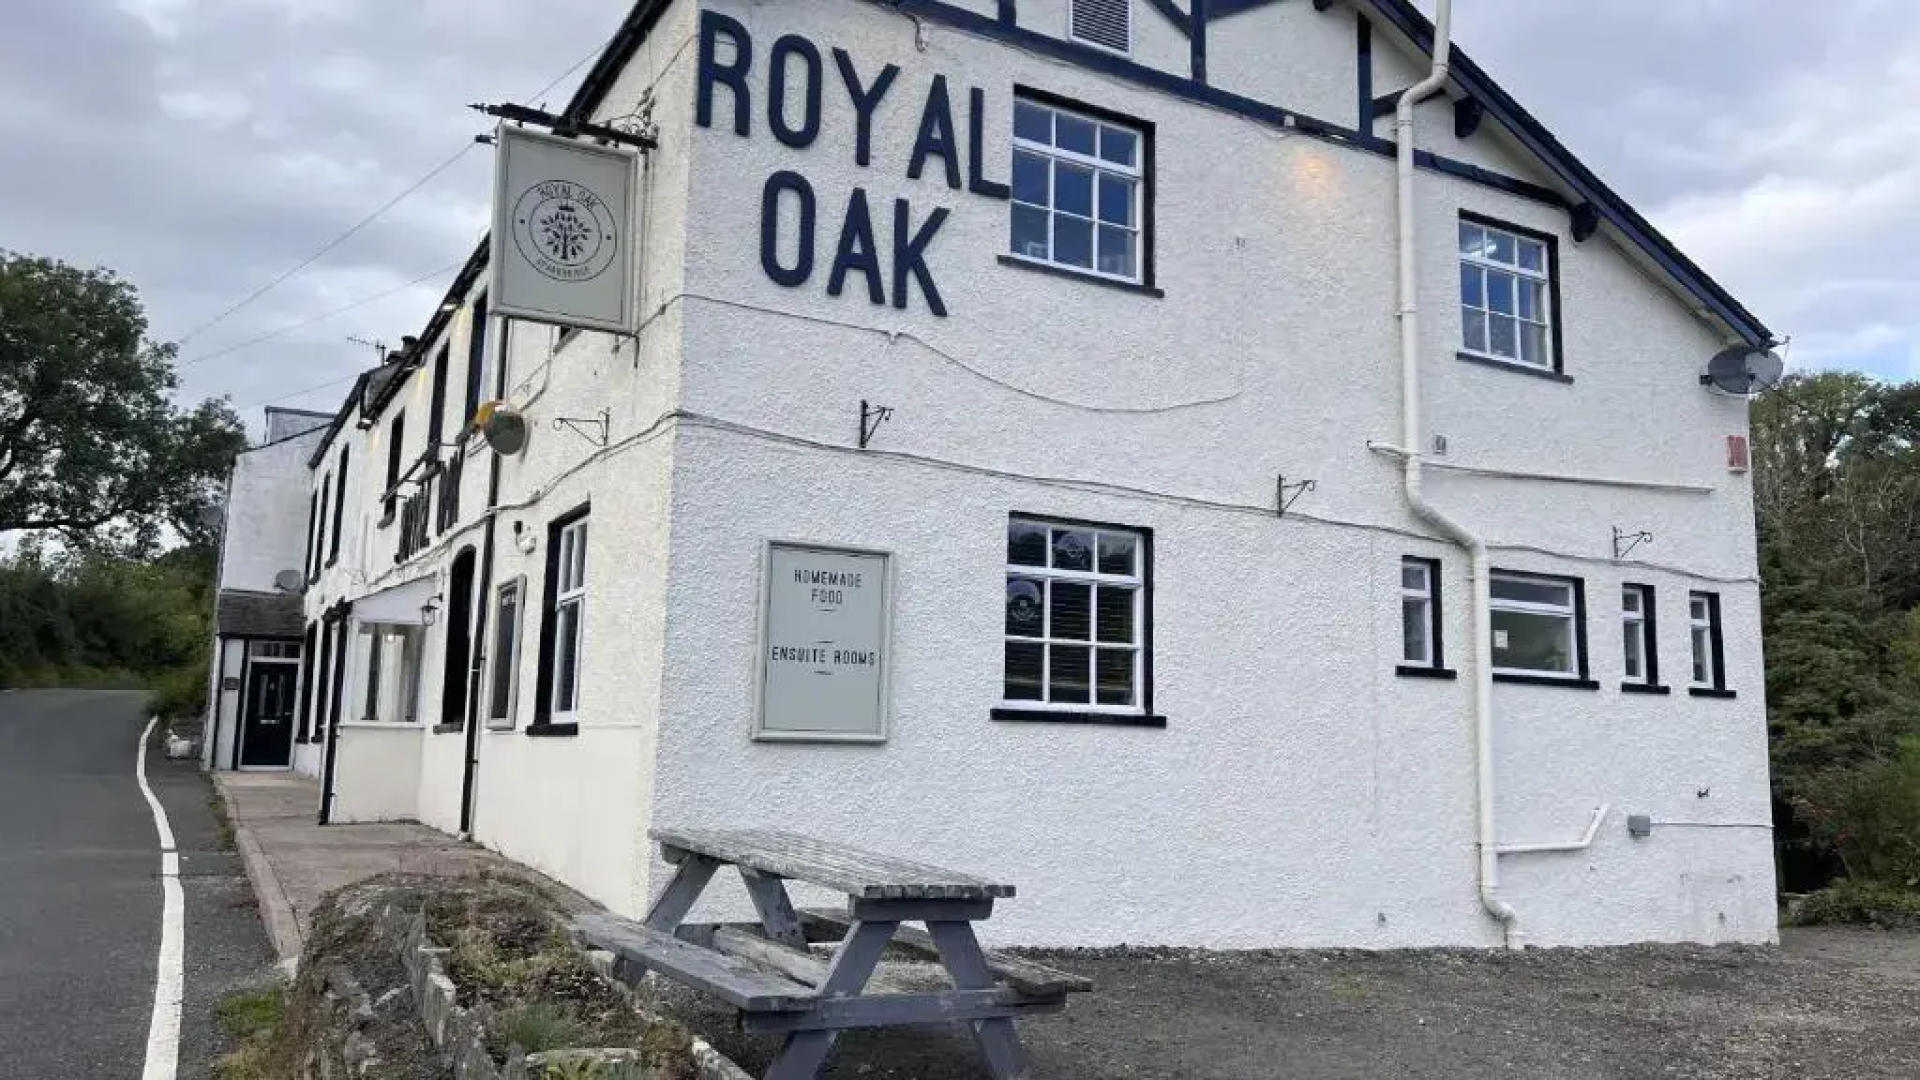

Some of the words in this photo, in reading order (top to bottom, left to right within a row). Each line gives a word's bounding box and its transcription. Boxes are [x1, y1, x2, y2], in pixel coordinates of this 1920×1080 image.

[696, 9, 1011, 200] ROYAL
[760, 170, 950, 317] OAK
[794, 569, 862, 588] HOMEMADE
[811, 588, 843, 604] FOOD
[772, 646, 826, 663] ENSUITE
[834, 650, 875, 666] ROOMS
